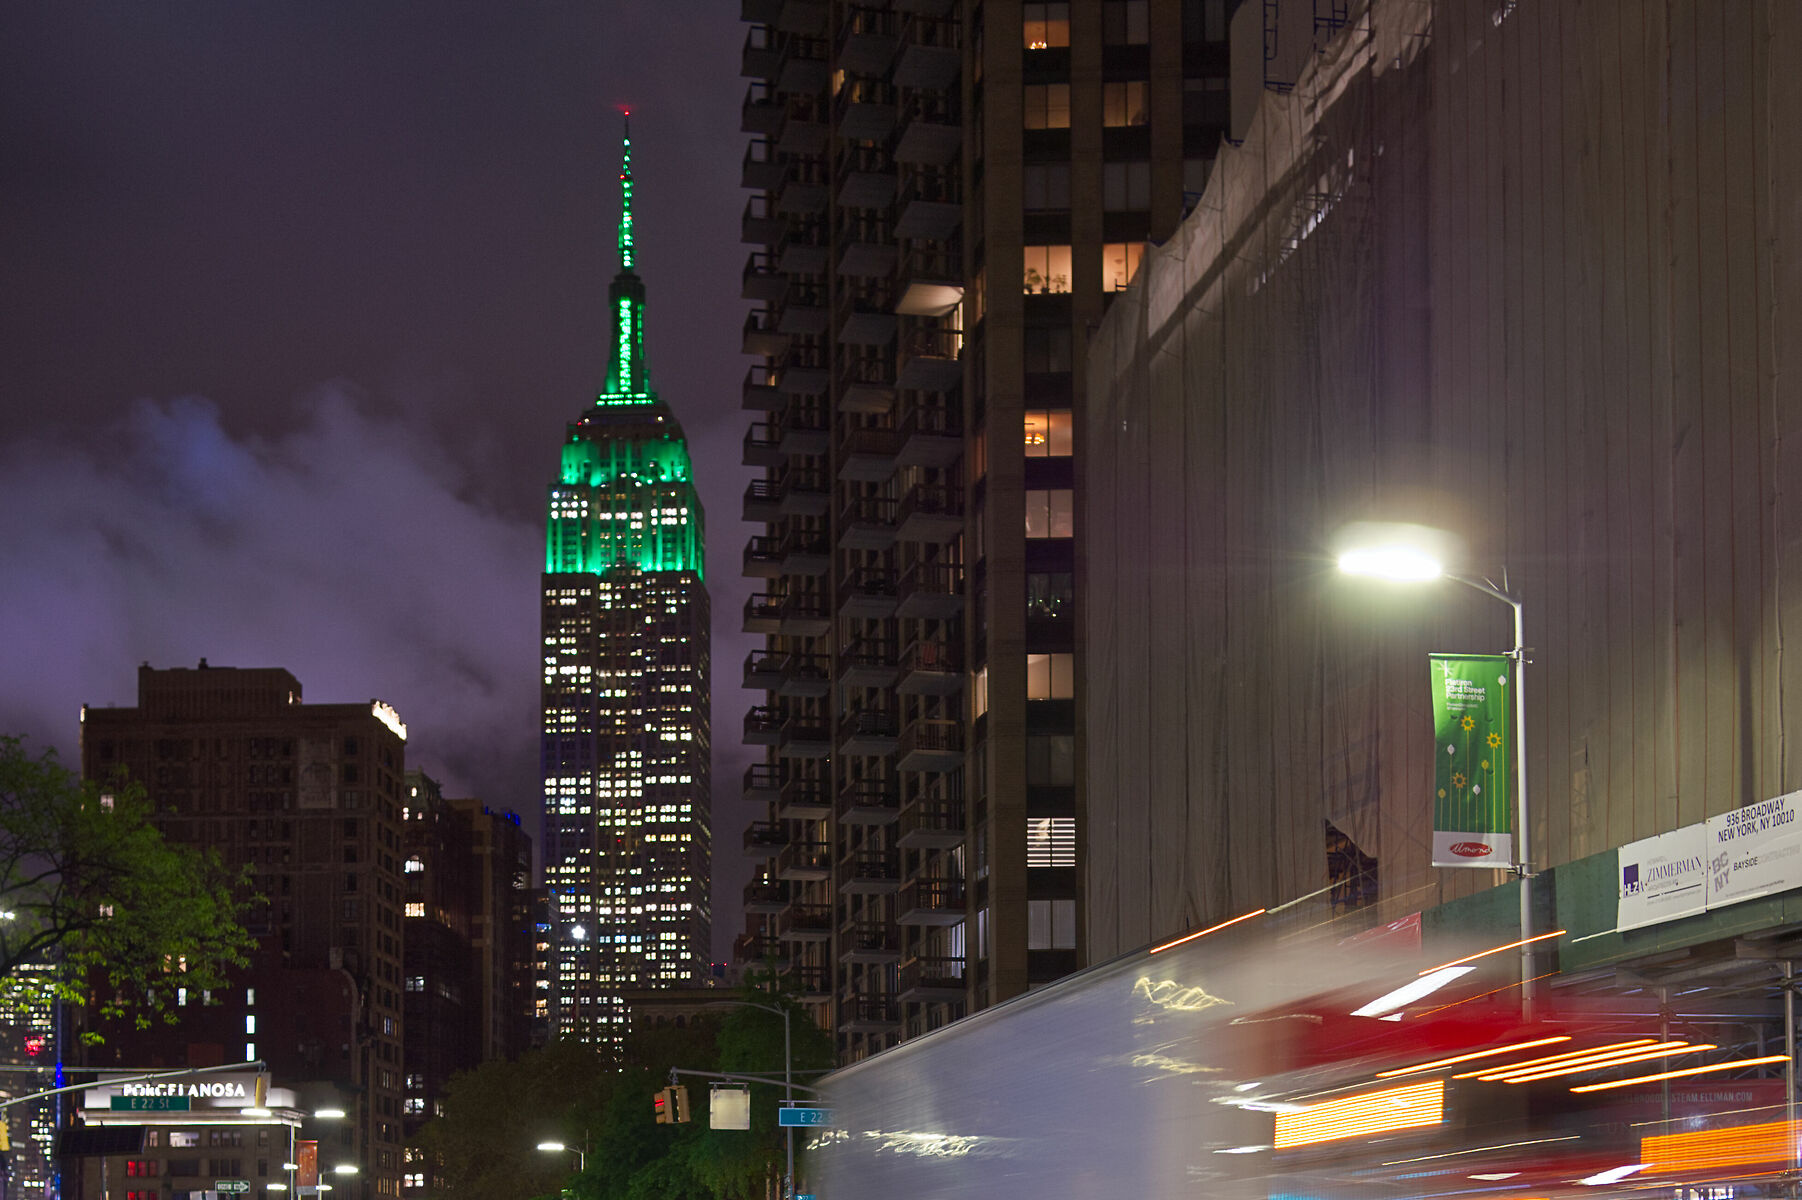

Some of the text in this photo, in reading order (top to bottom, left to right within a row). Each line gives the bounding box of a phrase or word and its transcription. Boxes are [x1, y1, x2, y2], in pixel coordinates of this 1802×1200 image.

[1446, 692, 1485, 702] Partnership
[1464, 687, 1485, 695] Street
[1726, 798, 1785, 827] 936 BROADWAY
[1718, 809, 1795, 843] NEW YORK, NY 10010
[1647, 855, 1702, 883] ZIMMERMAN
[1733, 856, 1758, 872] BAYSIDE
[1714, 868, 1730, 893] NY
[131, 1098, 170, 1109] E 22 St
[800, 1112, 806, 1122] E
[811, 1112, 823, 1122] 22
